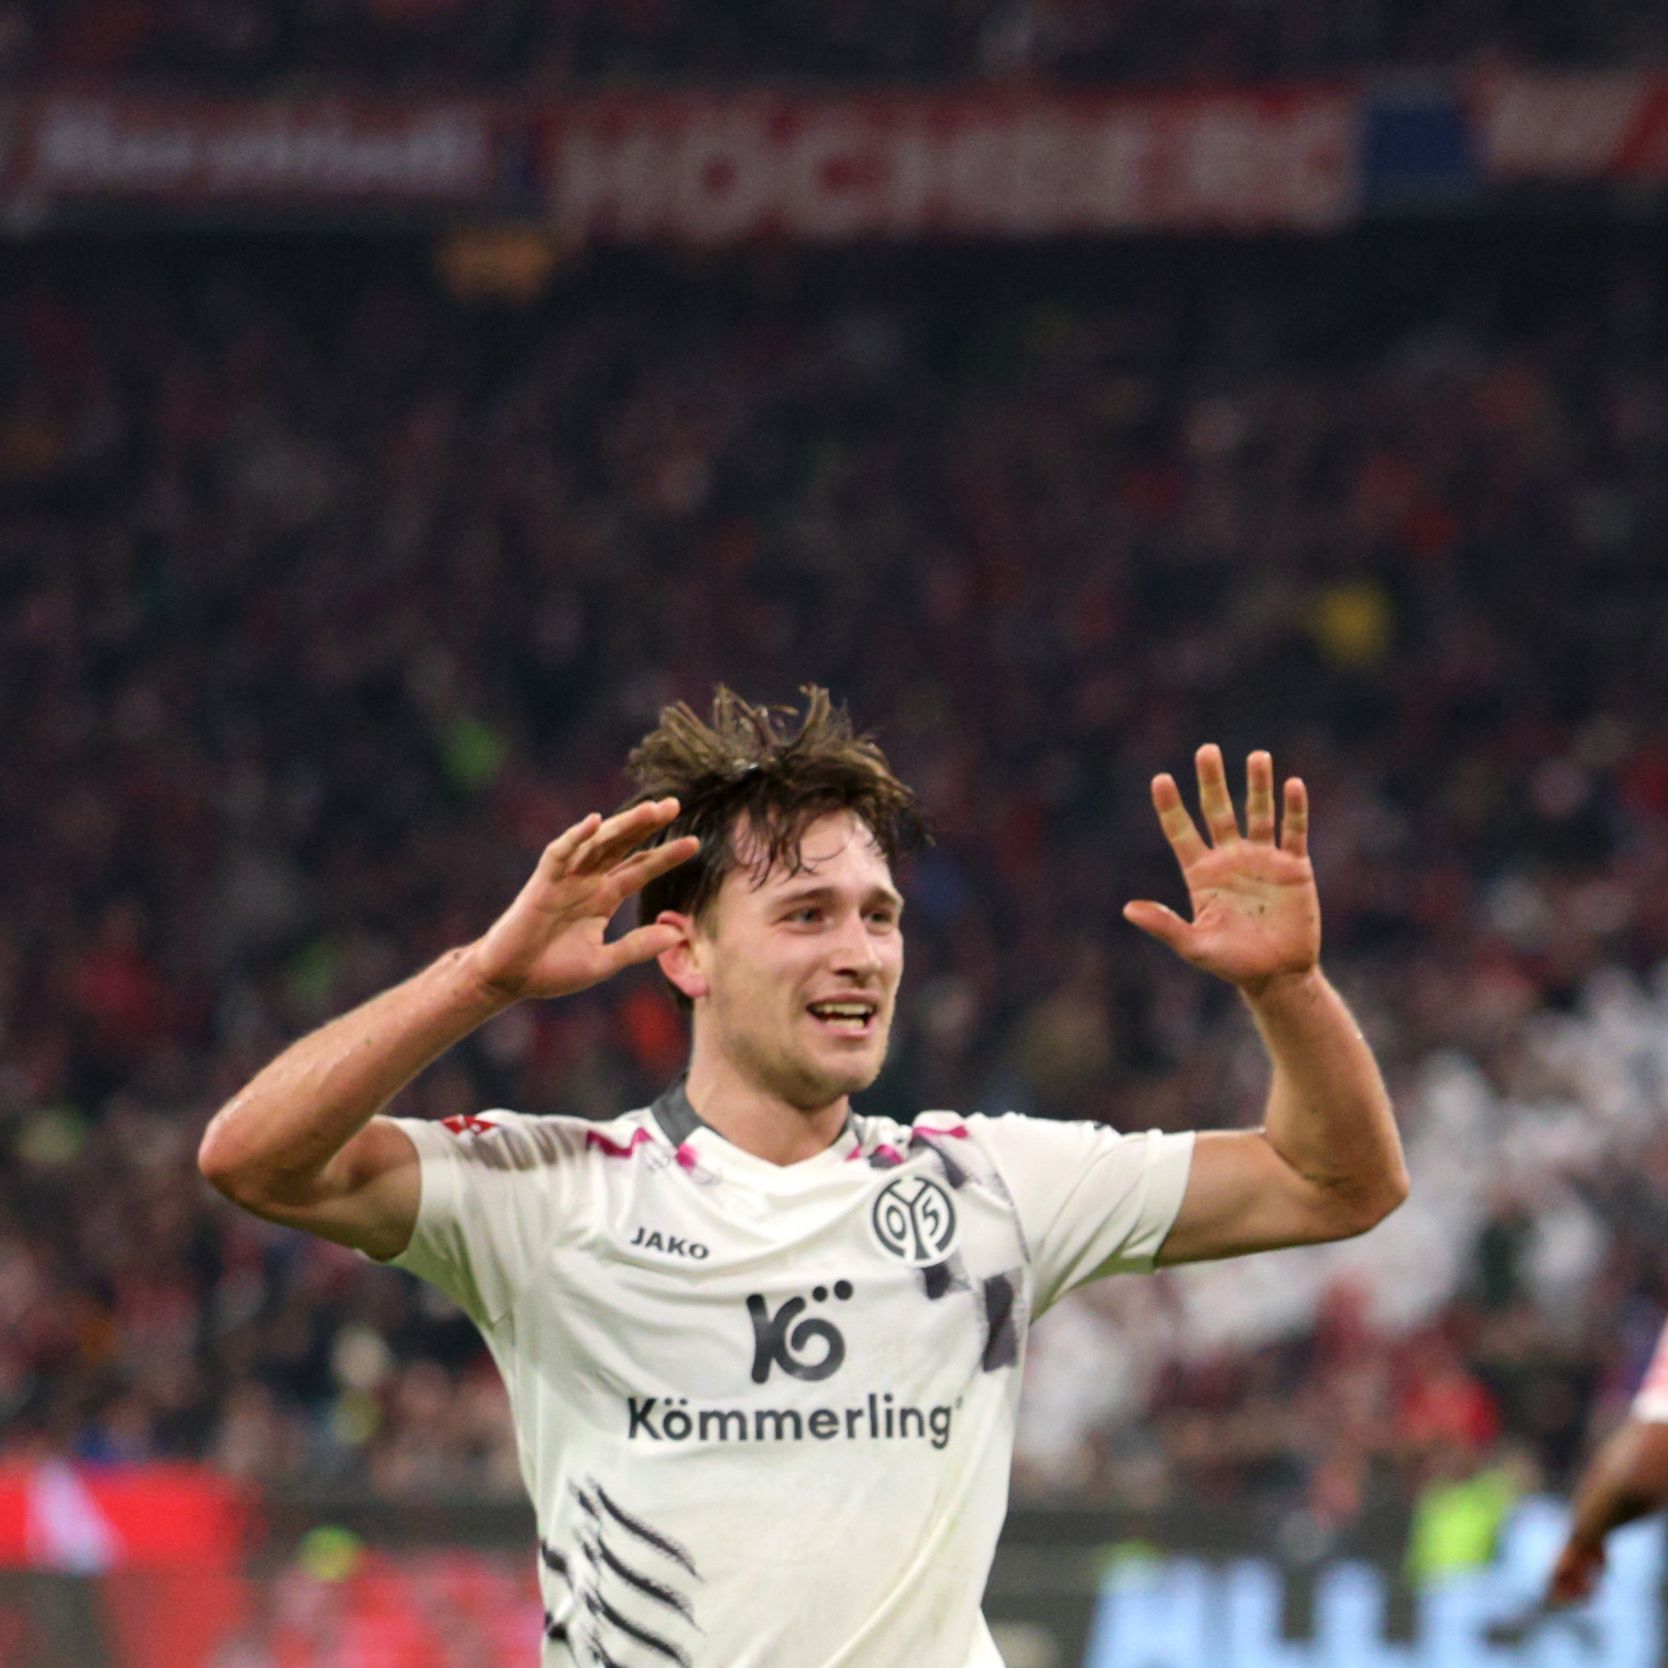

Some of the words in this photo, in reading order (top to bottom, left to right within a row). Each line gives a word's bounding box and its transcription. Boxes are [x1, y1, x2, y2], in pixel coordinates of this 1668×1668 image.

[554, 98, 1358, 236] HÖCHBERG
[630, 1227, 710, 1261] JAKO
[627, 1395, 953, 1451] Kömmerling
